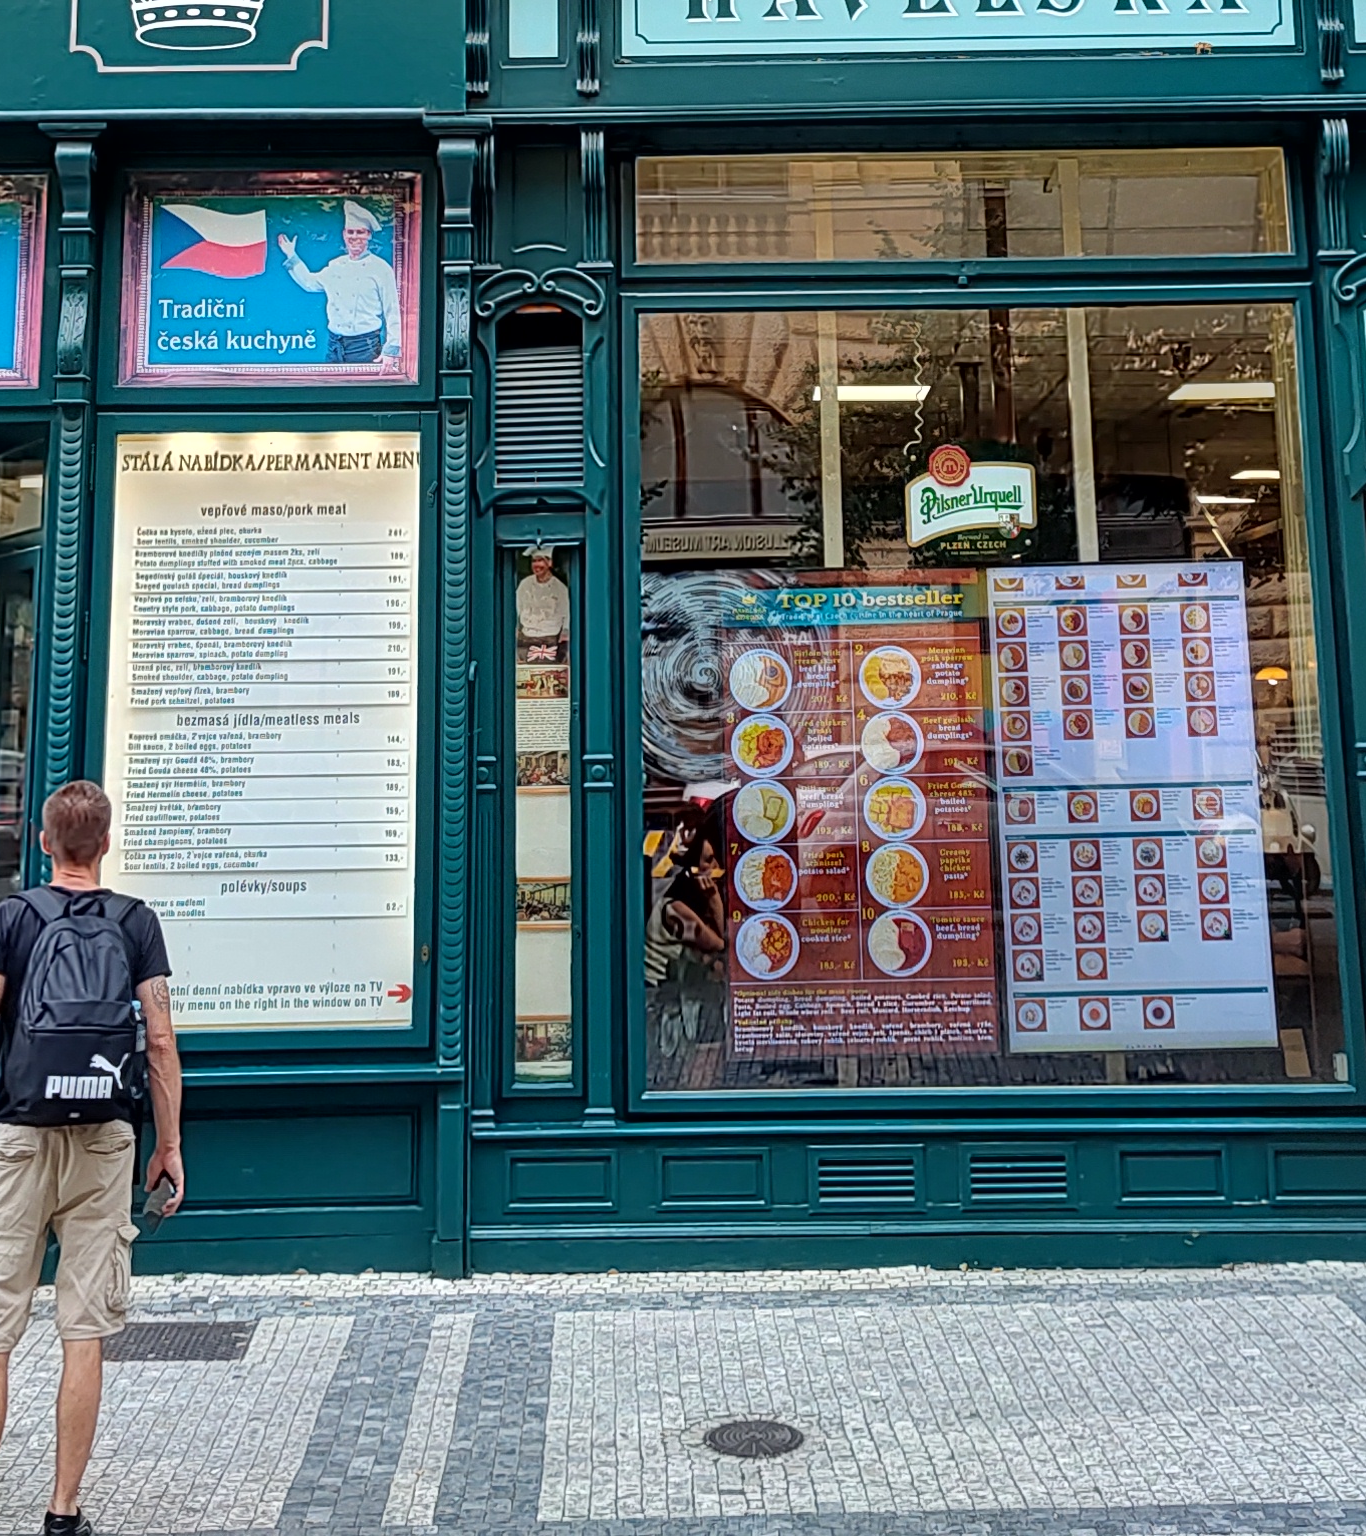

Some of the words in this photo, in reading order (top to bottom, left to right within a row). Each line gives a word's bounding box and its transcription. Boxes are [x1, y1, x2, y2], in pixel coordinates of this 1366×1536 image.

[158, 298, 246, 319] Tradiční
[157, 330, 219, 351] česká
[225, 329, 317, 354] kuchyně
[121, 450, 173, 471] STÁLÁ
[178, 450, 372, 471] NABÍDKA/PERMANENT
[200, 503, 246, 518] vepřové
[251, 503, 312, 518] maso/pork
[316, 503, 346, 515] meat
[920, 486, 973, 525] Pilsner
[970, 484, 1023, 512] Urquell
[862, 590, 964, 607] bestseller
[176, 711, 228, 726] bezmasá
[233, 711, 320, 728] jídla/meatless
[324, 710, 360, 724] meals
[220, 879, 306, 895] polévky/soups
[193, 983, 222, 995] denní
[223, 983, 263, 995] nabídka
[267, 984, 300, 996] vpravo
[304, 984, 315, 993] ve
[318, 981, 350, 994] výloze
[354, 983, 365, 992] na
[369, 980, 382, 992] TV
[172, 998, 185, 1012] ily
[187, 1001, 215, 1010] menu
[219, 1000, 231, 1010] on
[234, 998, 250, 1009] the
[253, 997, 277, 1011] right
[280, 997, 290, 1008] in
[293, 997, 309, 1008] the
[312, 996, 351, 1007] window
[354, 997, 366, 1007] on
[369, 995, 383, 1008] TV
[45, 1075, 113, 1099] PUMA
